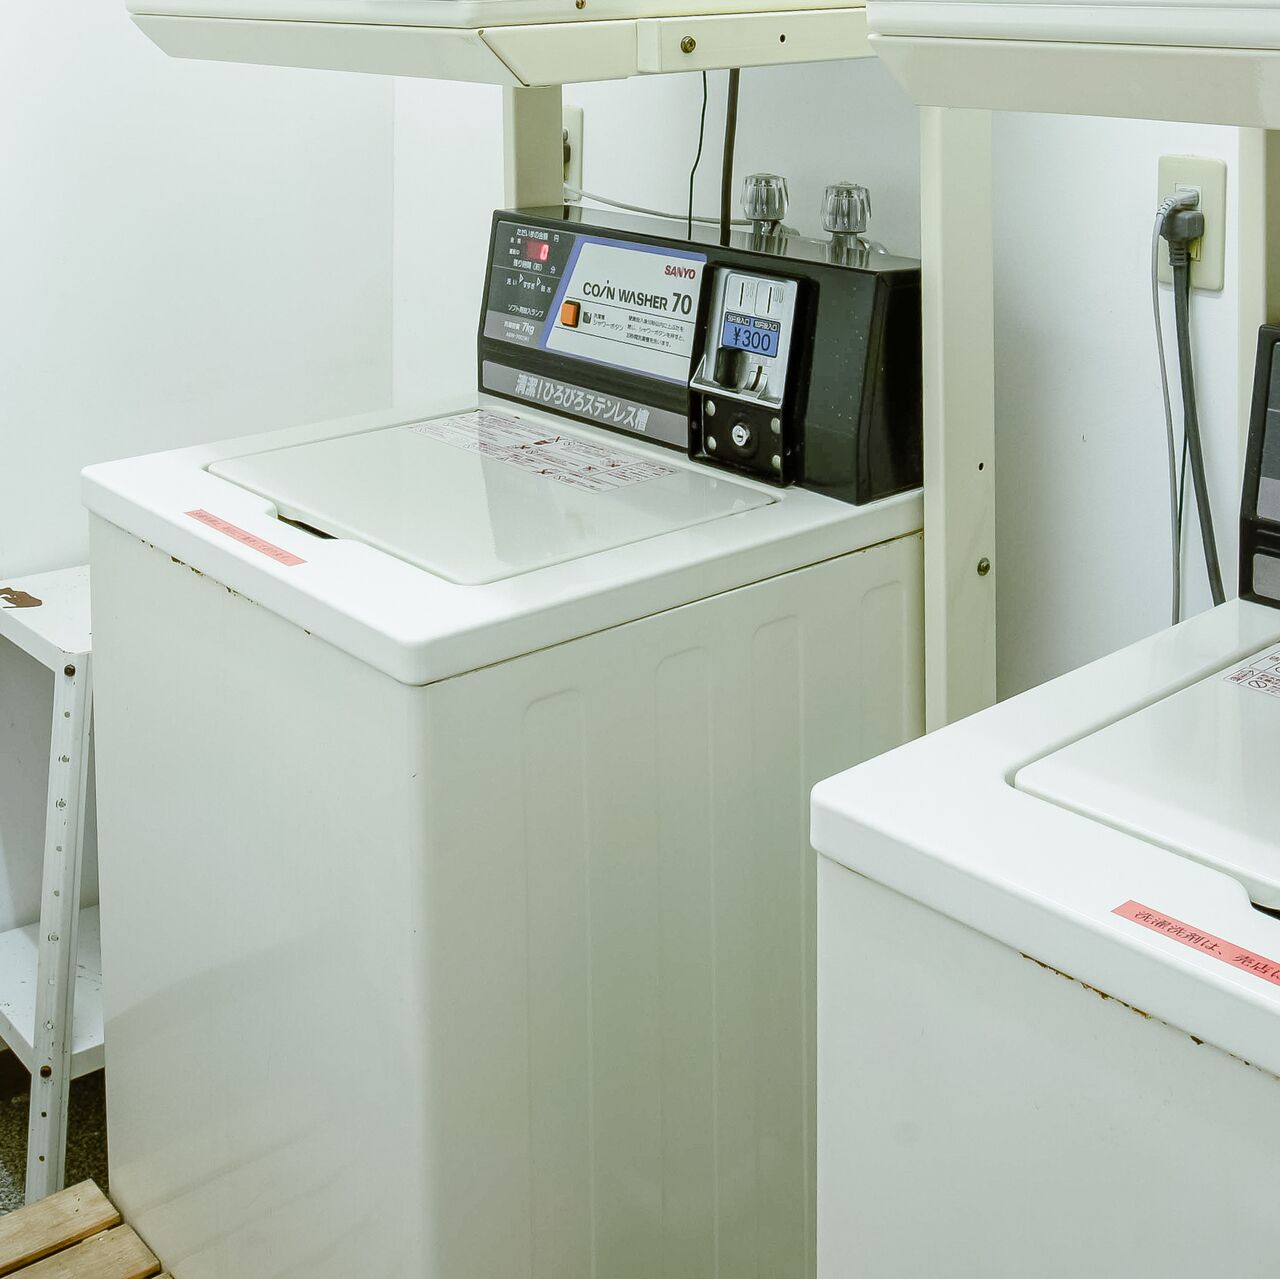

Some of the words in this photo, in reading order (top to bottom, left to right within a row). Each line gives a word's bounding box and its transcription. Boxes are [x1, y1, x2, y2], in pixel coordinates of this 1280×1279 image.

[664, 264, 696, 280] SANYO
[618, 288, 668, 311] WASHER
[671, 292, 693, 315] 70
[521, 321, 535, 336] 7kg
[733, 326, 771, 352] ¥300
